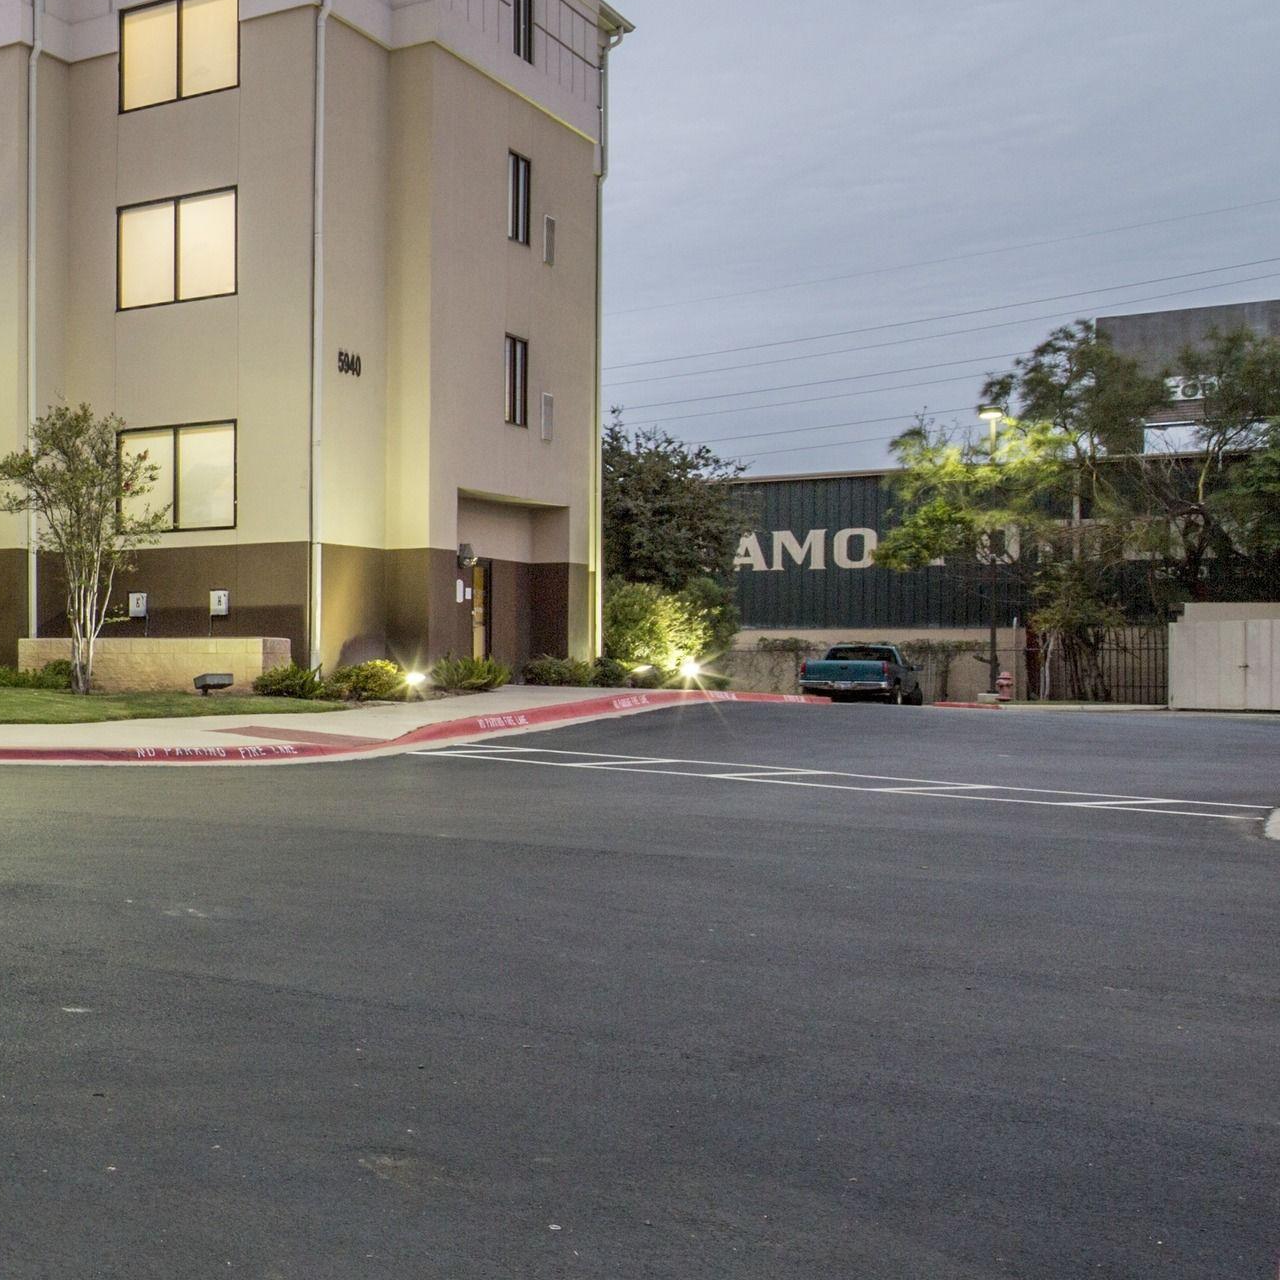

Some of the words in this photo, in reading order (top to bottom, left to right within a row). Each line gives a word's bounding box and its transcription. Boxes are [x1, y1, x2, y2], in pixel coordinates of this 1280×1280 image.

[338, 351, 361, 377] 5940
[704, 527, 877, 571] AMO
[136, 746, 155, 758] NO
[239, 746, 266, 759] FIRE
